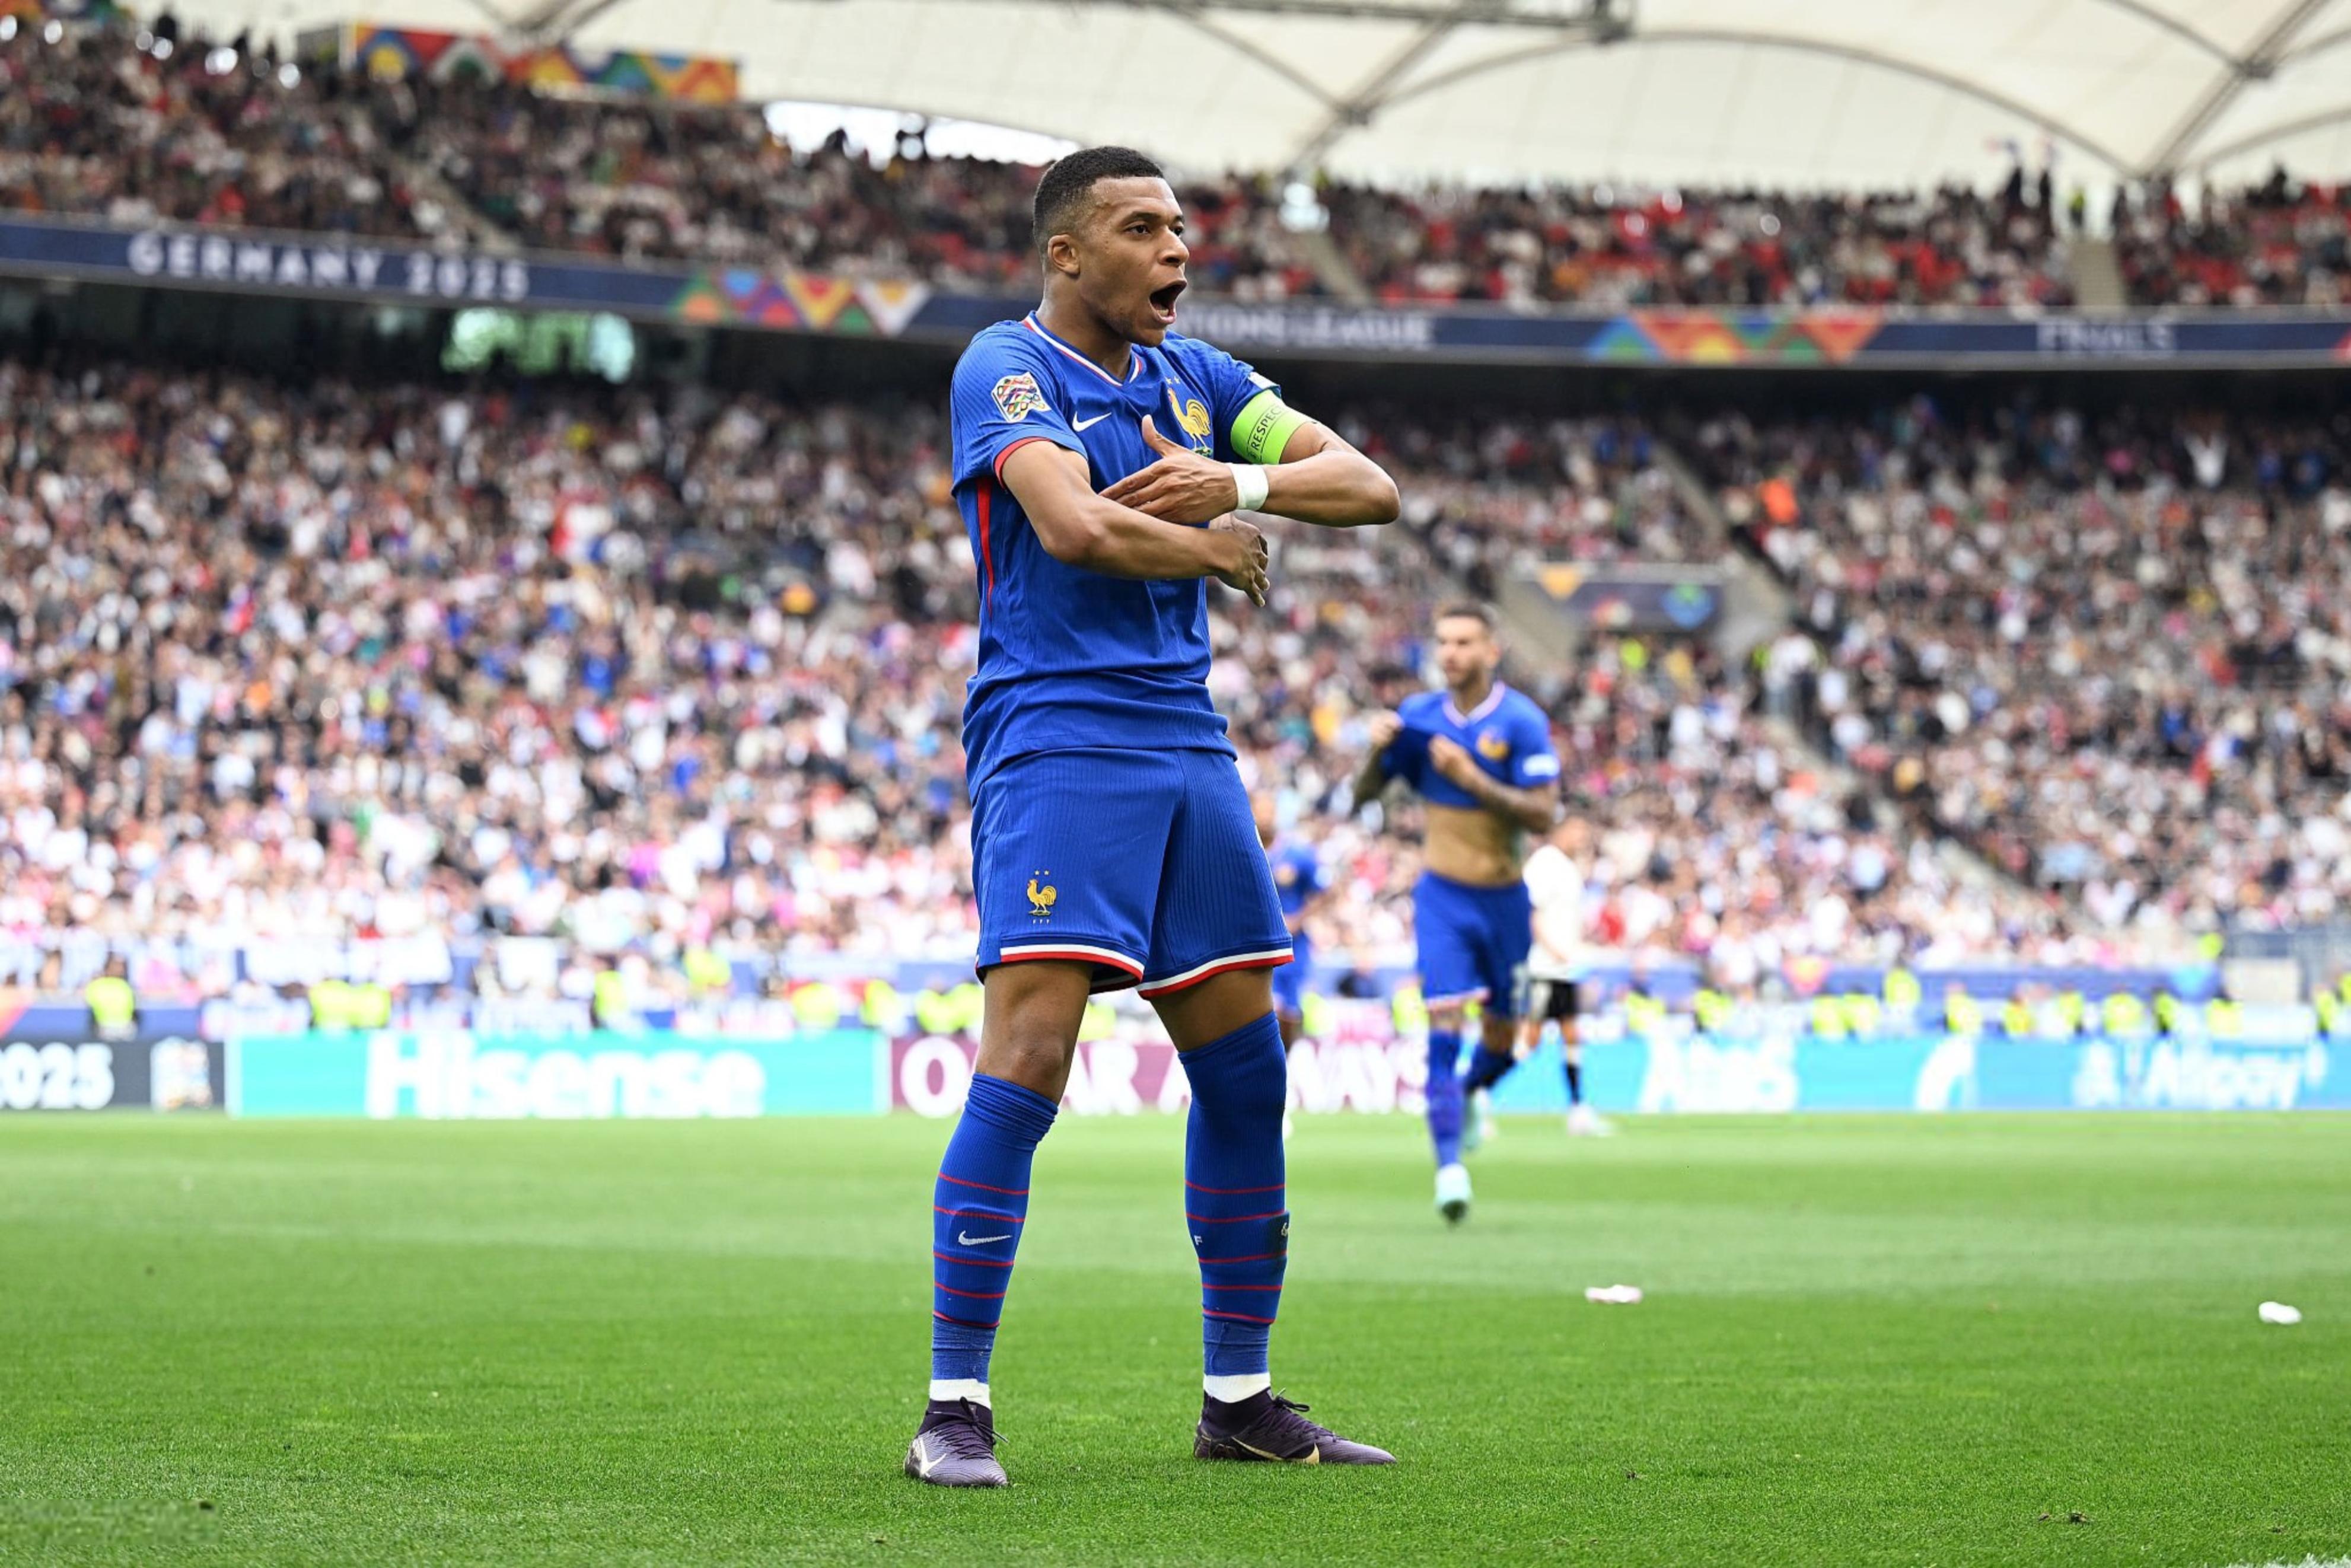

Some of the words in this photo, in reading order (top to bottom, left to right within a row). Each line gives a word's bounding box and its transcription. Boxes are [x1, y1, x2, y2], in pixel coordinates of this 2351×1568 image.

[126, 232, 384, 291] GERMANY
[406, 249, 530, 301] 2025
[0, 1042, 114, 1111] 025
[365, 1029, 766, 1120] Hisense
